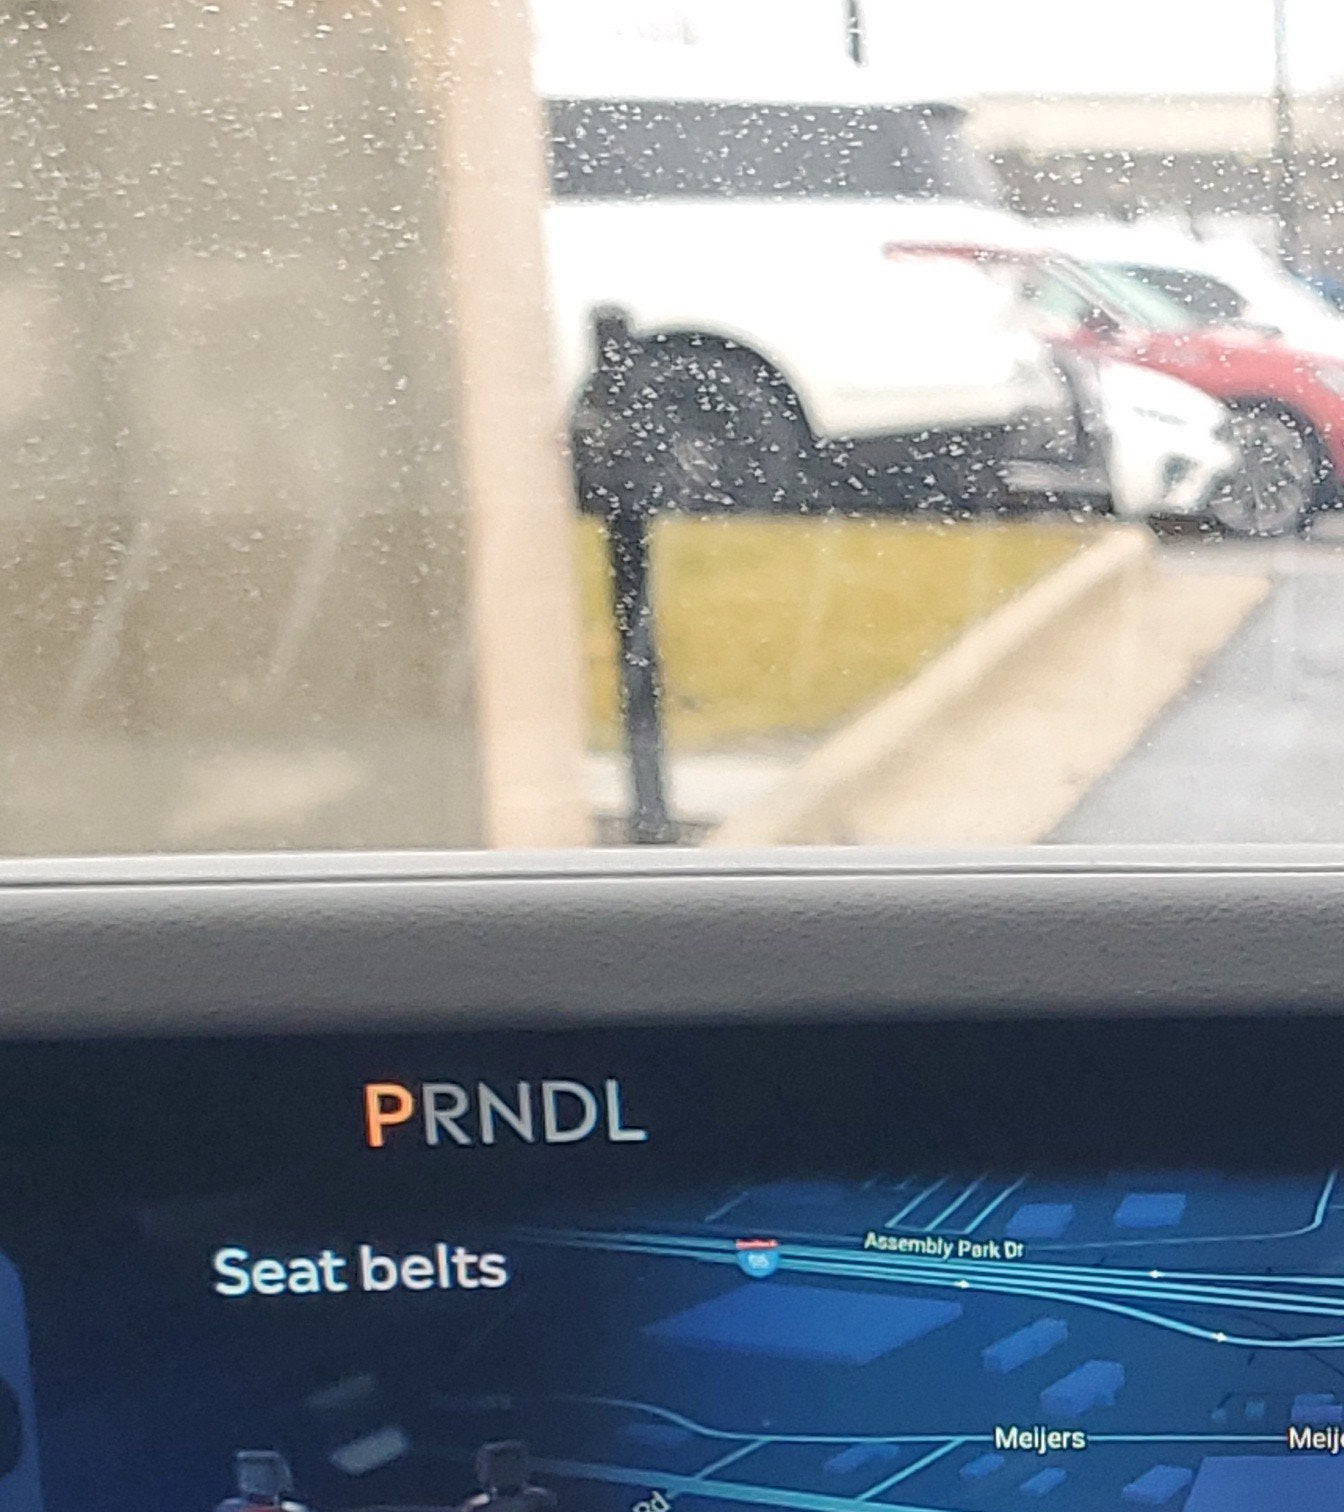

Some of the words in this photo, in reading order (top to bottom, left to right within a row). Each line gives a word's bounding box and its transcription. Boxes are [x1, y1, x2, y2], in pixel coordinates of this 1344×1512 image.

[364, 1079, 649, 1148] PRNDL
[864, 1231, 952, 1260] Assembly
[957, 1238, 1000, 1260] Park
[1004, 1240, 1024, 1260] Dr
[212, 1248, 348, 1296] Seat
[360, 1242, 508, 1292] belts
[995, 1427, 1086, 1455] Meijers
